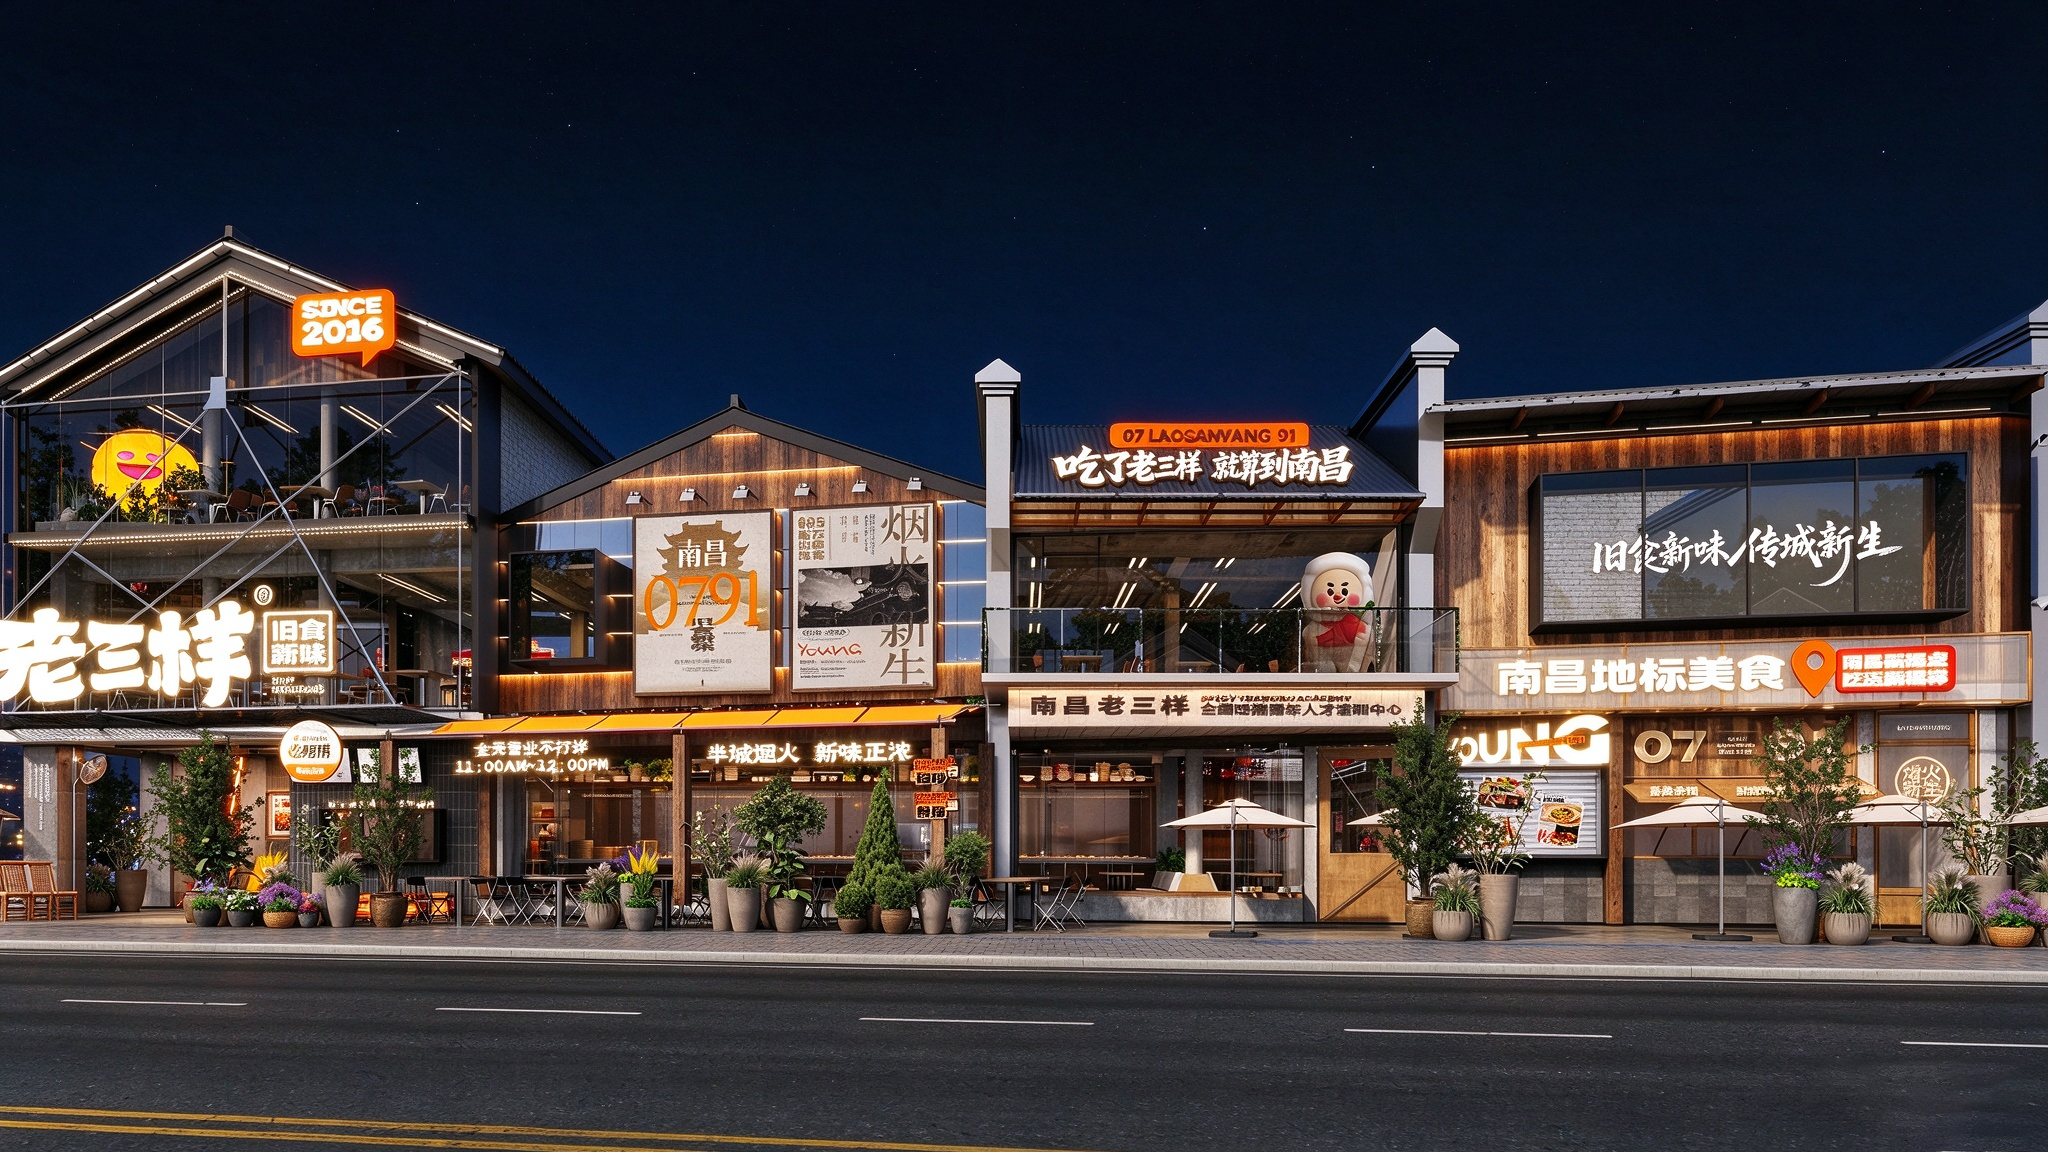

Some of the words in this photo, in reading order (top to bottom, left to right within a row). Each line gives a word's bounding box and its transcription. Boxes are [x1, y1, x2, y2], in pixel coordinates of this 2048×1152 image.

[301, 296, 382, 319] SINCE
[301, 316, 385, 346] 2016
[1122, 428, 1144, 443] 07
[1278, 428, 1296, 443] 91
[1052, 445, 1203, 485] 吃了老三样
[1212, 446, 1353, 486] 就算到南昌
[678, 538, 728, 569] 南昌
[643, 569, 761, 632] 0791
[879, 505, 930, 684] 烟火新生
[270, 617, 327, 642] 旧食
[0, 600, 254, 707] 老三样
[1497, 654, 1786, 696] 南昌地标美食
[1030, 694, 1190, 717] 南昌老三样
[1633, 730, 1707, 764] 07
